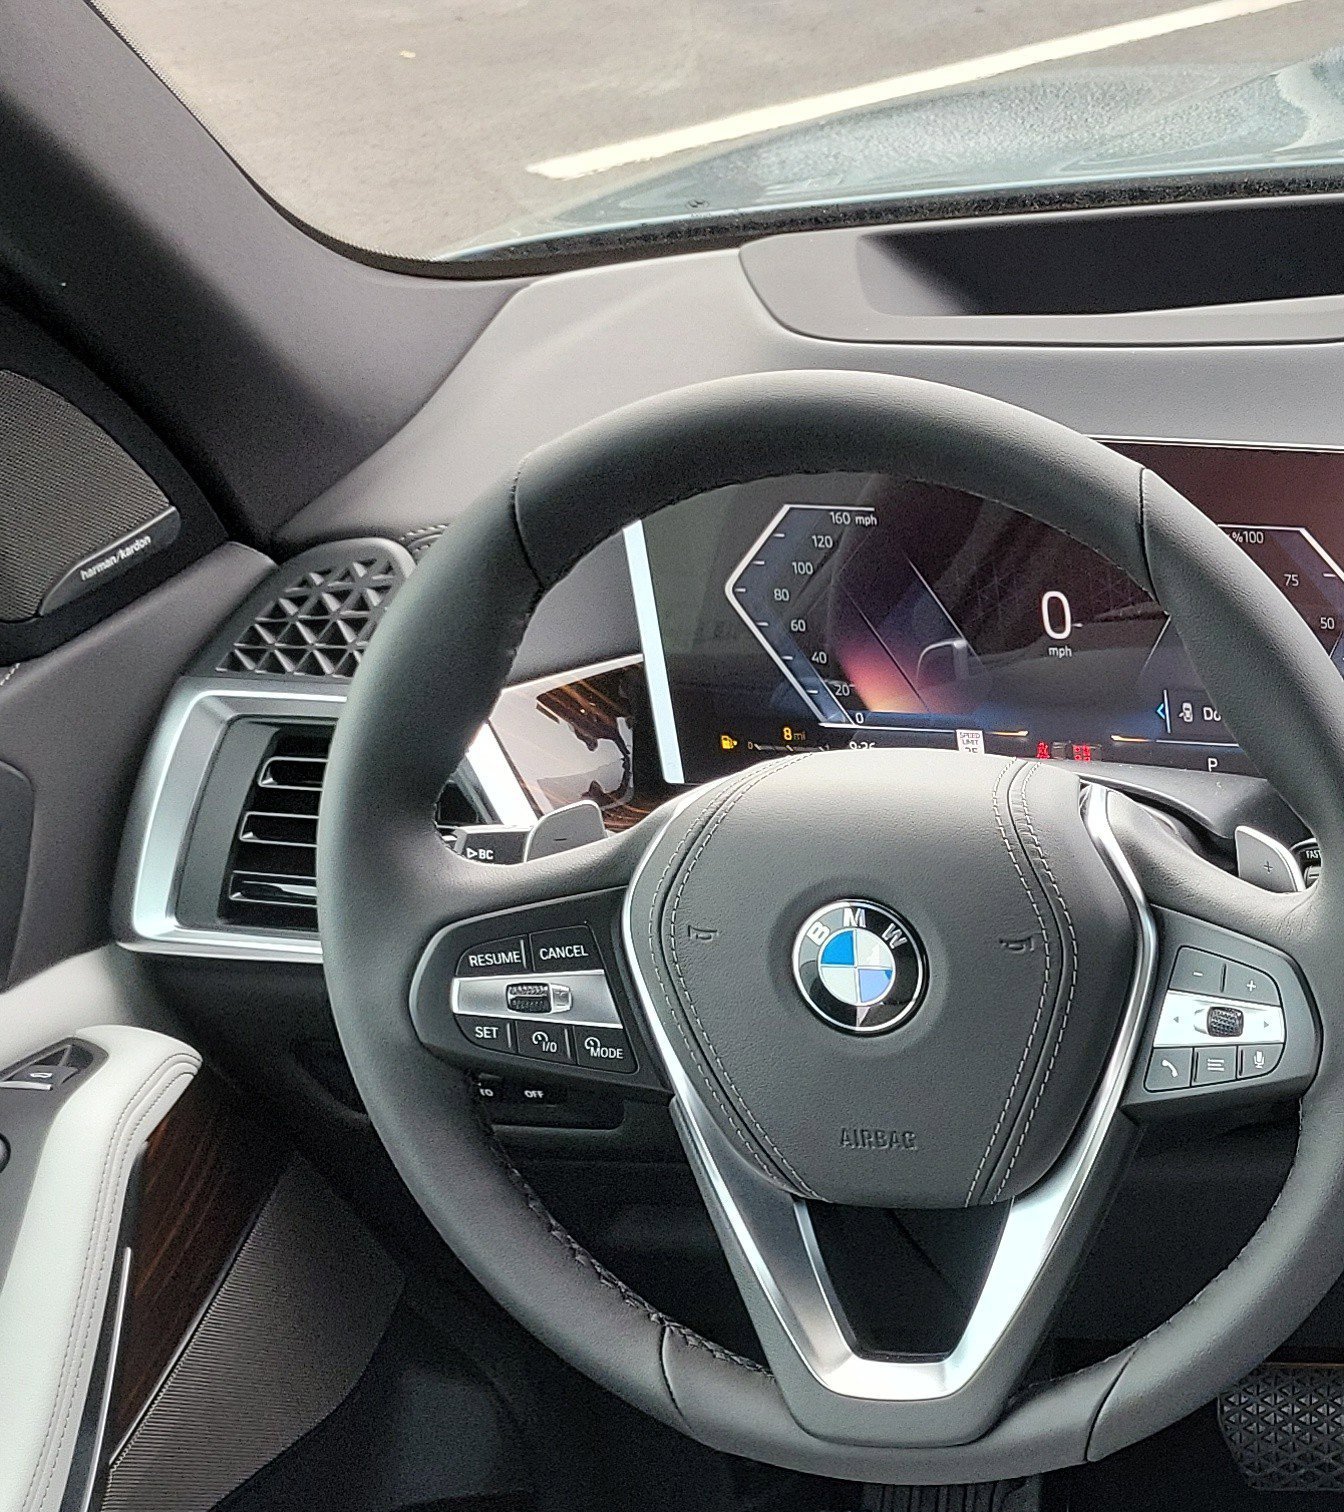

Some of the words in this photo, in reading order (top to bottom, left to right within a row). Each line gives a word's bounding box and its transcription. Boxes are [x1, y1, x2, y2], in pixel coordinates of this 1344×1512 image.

[829, 512, 850, 524] 160
[855, 515, 877, 526] mph
[812, 535, 833, 548] 120
[80, 534, 151, 581] harman/kardon
[792, 561, 814, 575] 100
[1283, 574, 1299, 586] 75
[774, 589, 790, 601] 80
[1041, 590, 1072, 640] 0
[790, 619, 806, 632] 60
[1320, 617, 1335, 630] 50
[811, 652, 827, 664] 40
[1048, 646, 1072, 658] mph
[835, 684, 850, 696] 20
[855, 712, 864, 723] 0
[1203, 706, 1222, 722] Do
[806, 907, 908, 949] BMW
[468, 950, 521, 967] RESUME
[540, 945, 588, 960] CANCEL
[475, 1026, 499, 1038] SET
[590, 1046, 624, 1059] MODE
[840, 1127, 917, 1150] AIRBAG
